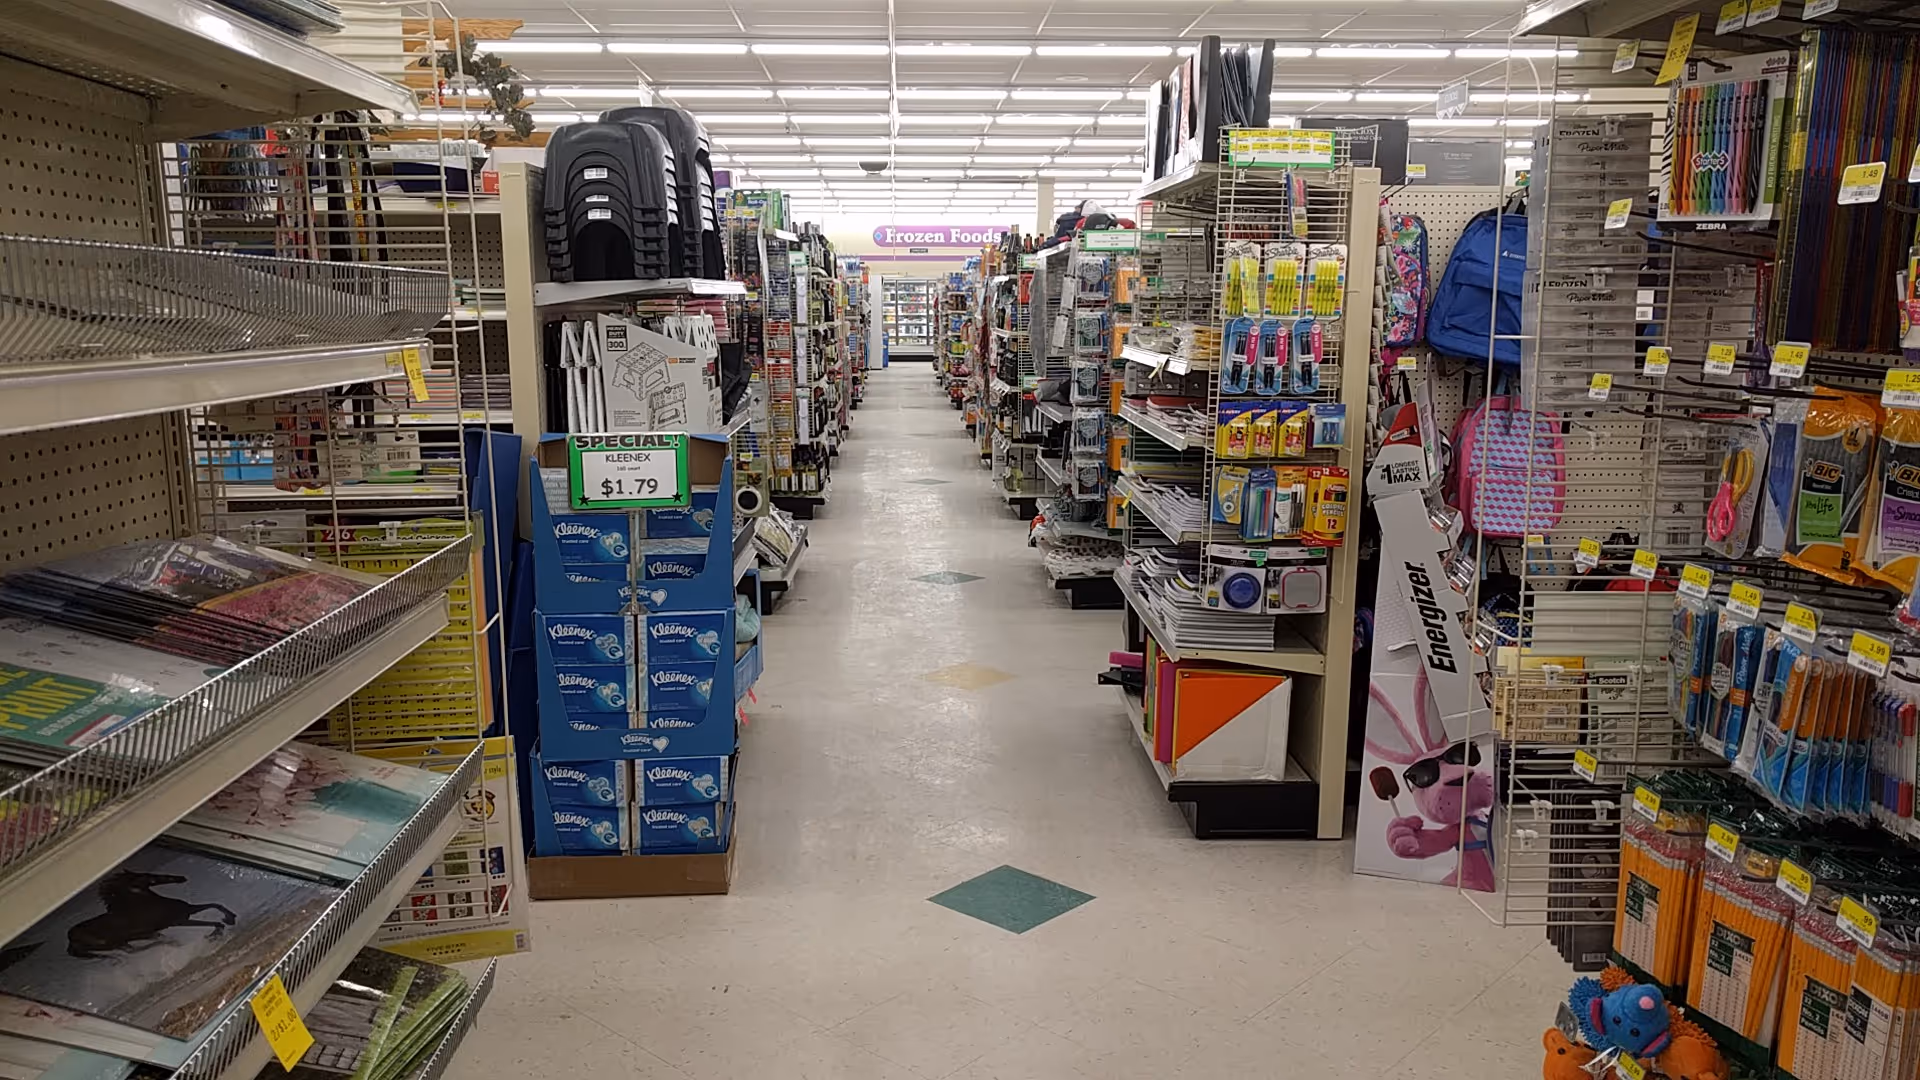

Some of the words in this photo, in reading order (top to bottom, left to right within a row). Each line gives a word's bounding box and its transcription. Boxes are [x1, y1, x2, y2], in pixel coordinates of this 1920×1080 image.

[1862, 169, 1878, 179] 1.49
[885, 228, 945, 243] Frozen
[950, 228, 1002, 243] Foods
[576, 434, 680, 449] SPECIAL!
[605, 453, 652, 463] KLEENEX
[1391, 460, 1419, 468] LONGEST
[1392, 466, 1420, 474] LASTING
[1393, 472, 1421, 483] MAX
[1814, 465, 1839, 479] BIC
[1900, 469, 1920, 481] BI
[601, 478, 658, 498] $1.79
[1816, 497, 1834, 514] Life
[554, 522, 599, 538] Kleenex
[1327, 519, 1337, 529] 12
[648, 561, 692, 577] Kleenex
[1745, 591, 1757, 600] 1.49
[1403, 560, 1458, 674] Energizer
[548, 623, 595, 640] Kleenex
[650, 623, 695, 639] Kleenex
[1869, 643, 1886, 656] 3.99
[558, 673, 597, 689] leenex
[650, 671, 695, 687] Kleenex
[620, 734, 652, 746] Kleenex
[544, 766, 588, 782] Kleenex
[647, 766, 691, 782] Kleenex
[553, 811, 591, 827] leenex
[643, 809, 687, 824] Kleenex
[1721, 832, 1734, 845] 2.99
[1715, 927, 1750, 949] DIXON
[1802, 1007, 1813, 1018] No.
[1800, 1020, 1825, 1035] Pencils
